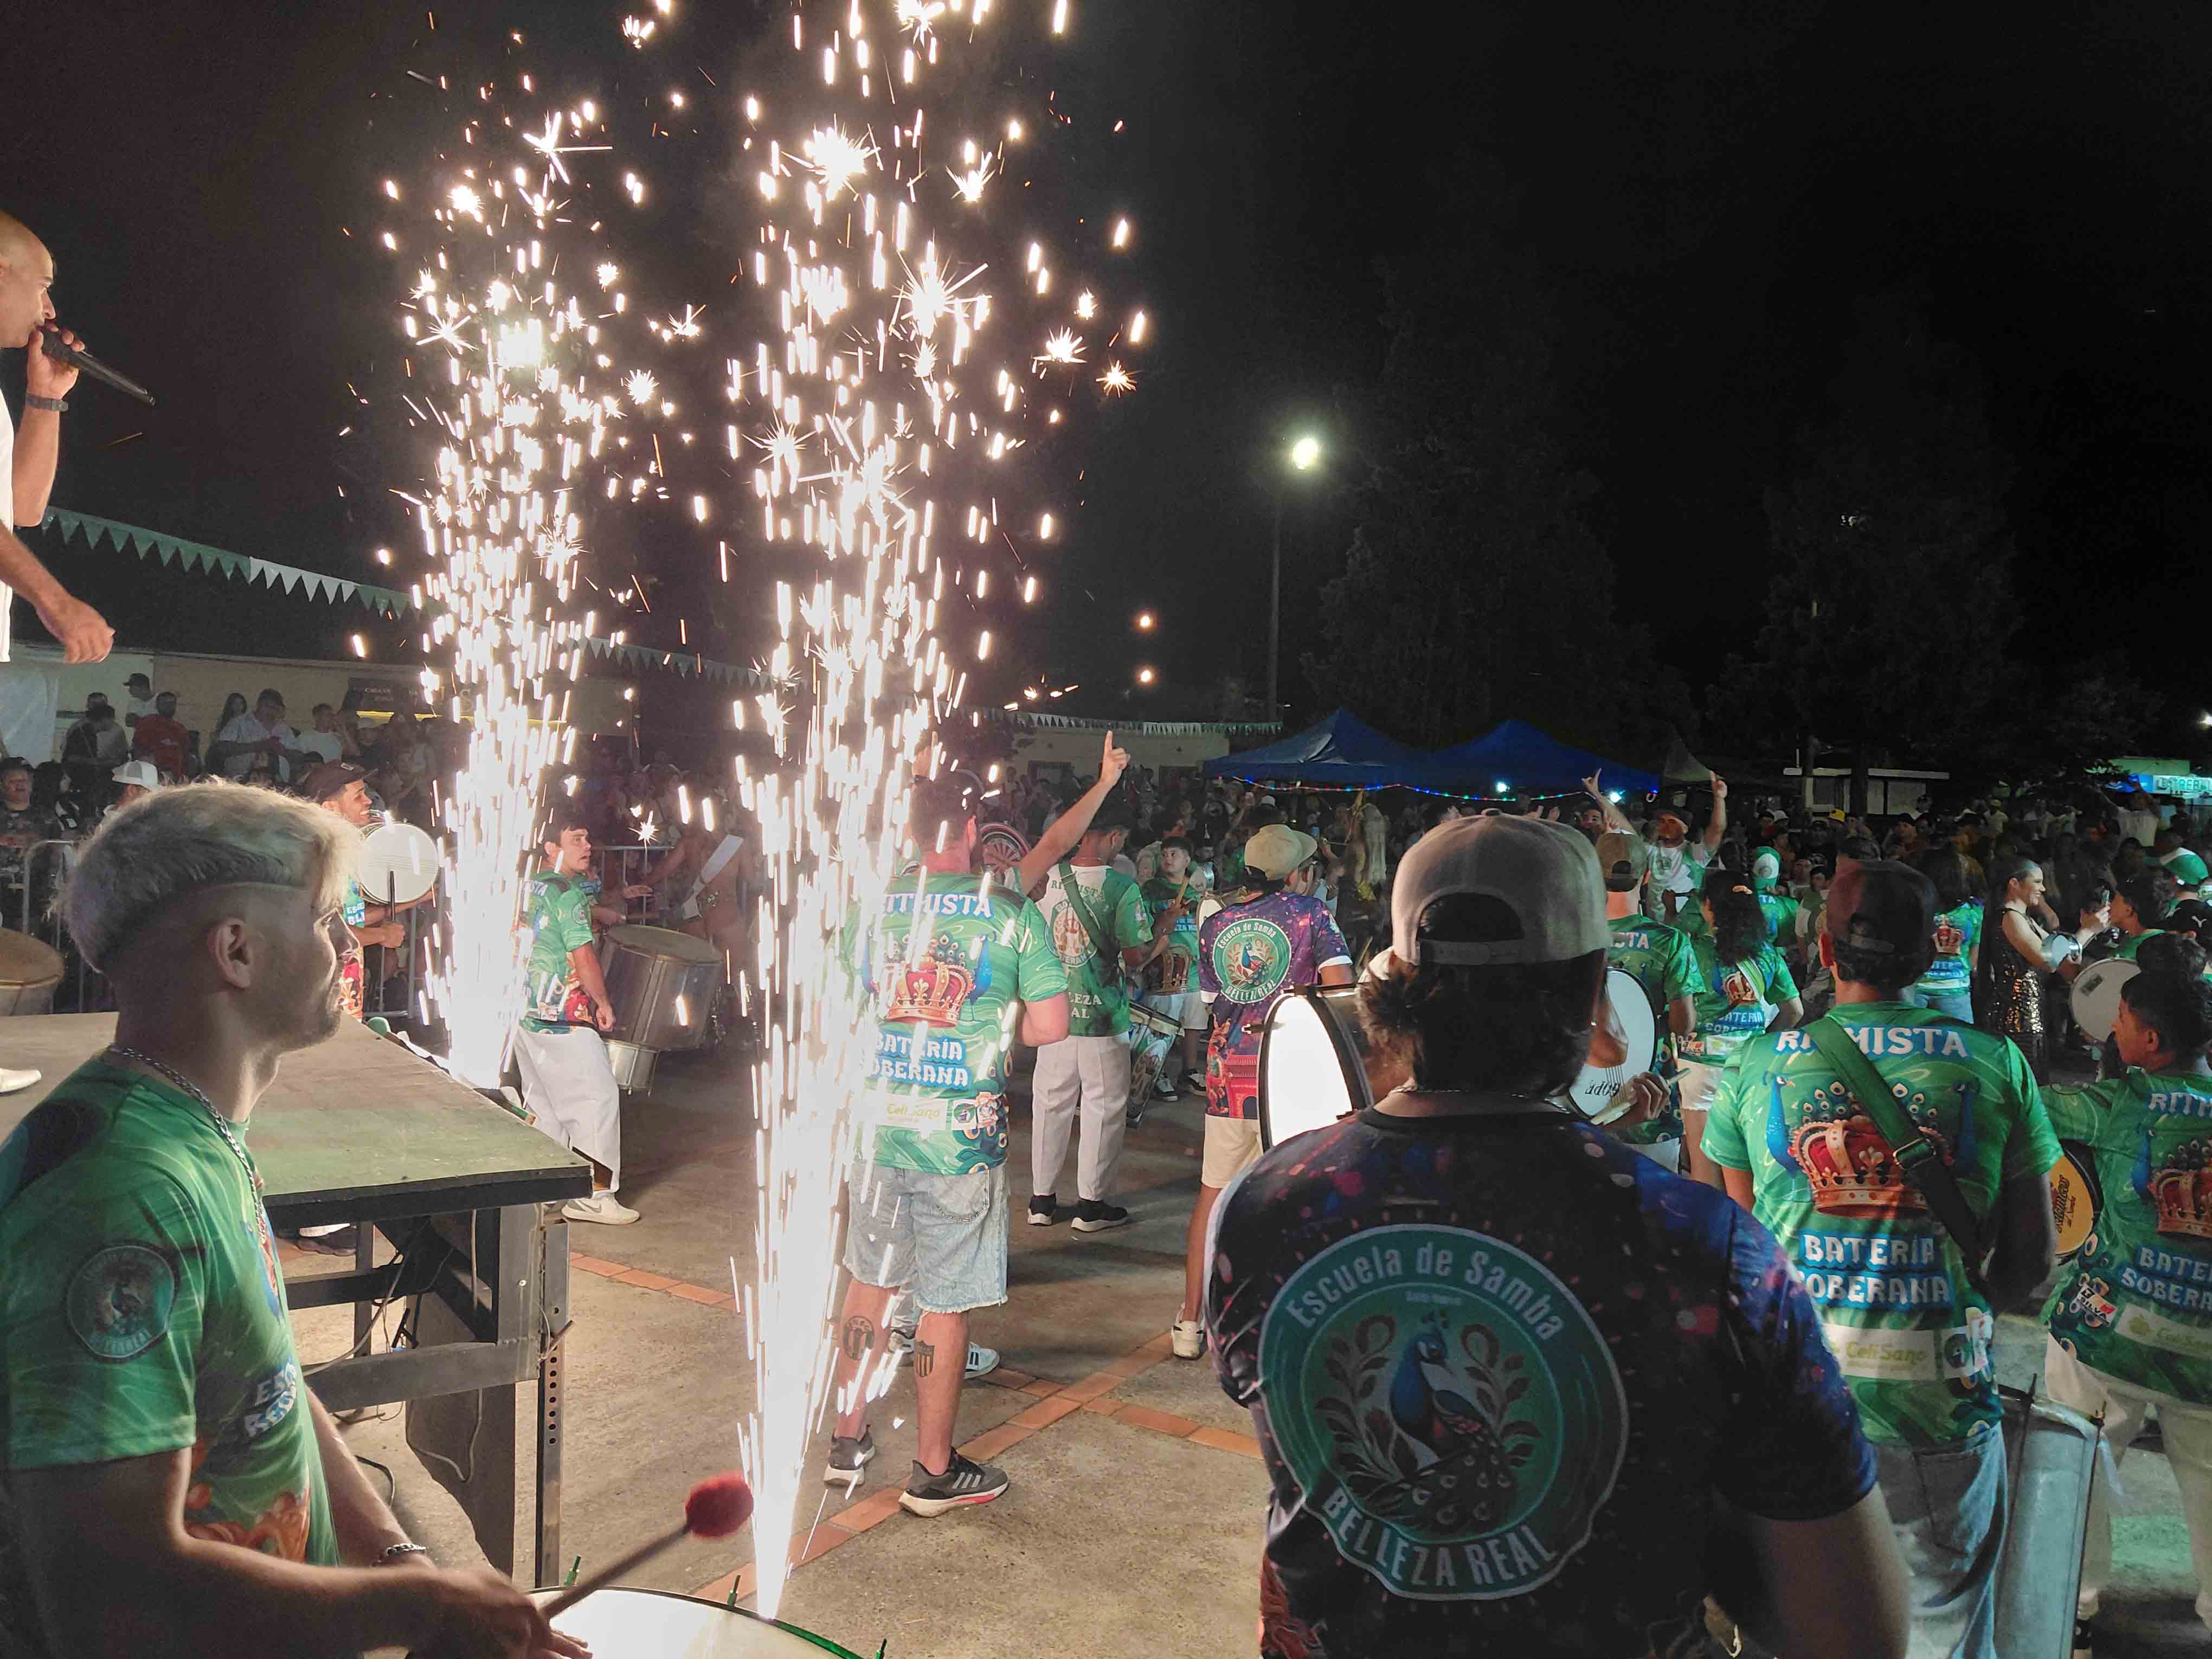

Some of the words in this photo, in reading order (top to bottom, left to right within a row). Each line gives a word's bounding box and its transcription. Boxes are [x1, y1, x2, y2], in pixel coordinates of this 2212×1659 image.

[1217, 926, 1242, 949] Escuela
[1243, 923, 1252, 931] de
[1253, 922, 1276, 937] Samba
[1776, 1027, 1968, 1058] RIMISTA
[1285, 1245, 1404, 1328] Escuela
[1415, 1241, 1454, 1277] de
[1465, 1250, 1564, 1340] Samba
[1322, 1487, 1457, 1587] BELLEZA
[1464, 1524, 1557, 1585] REAL
